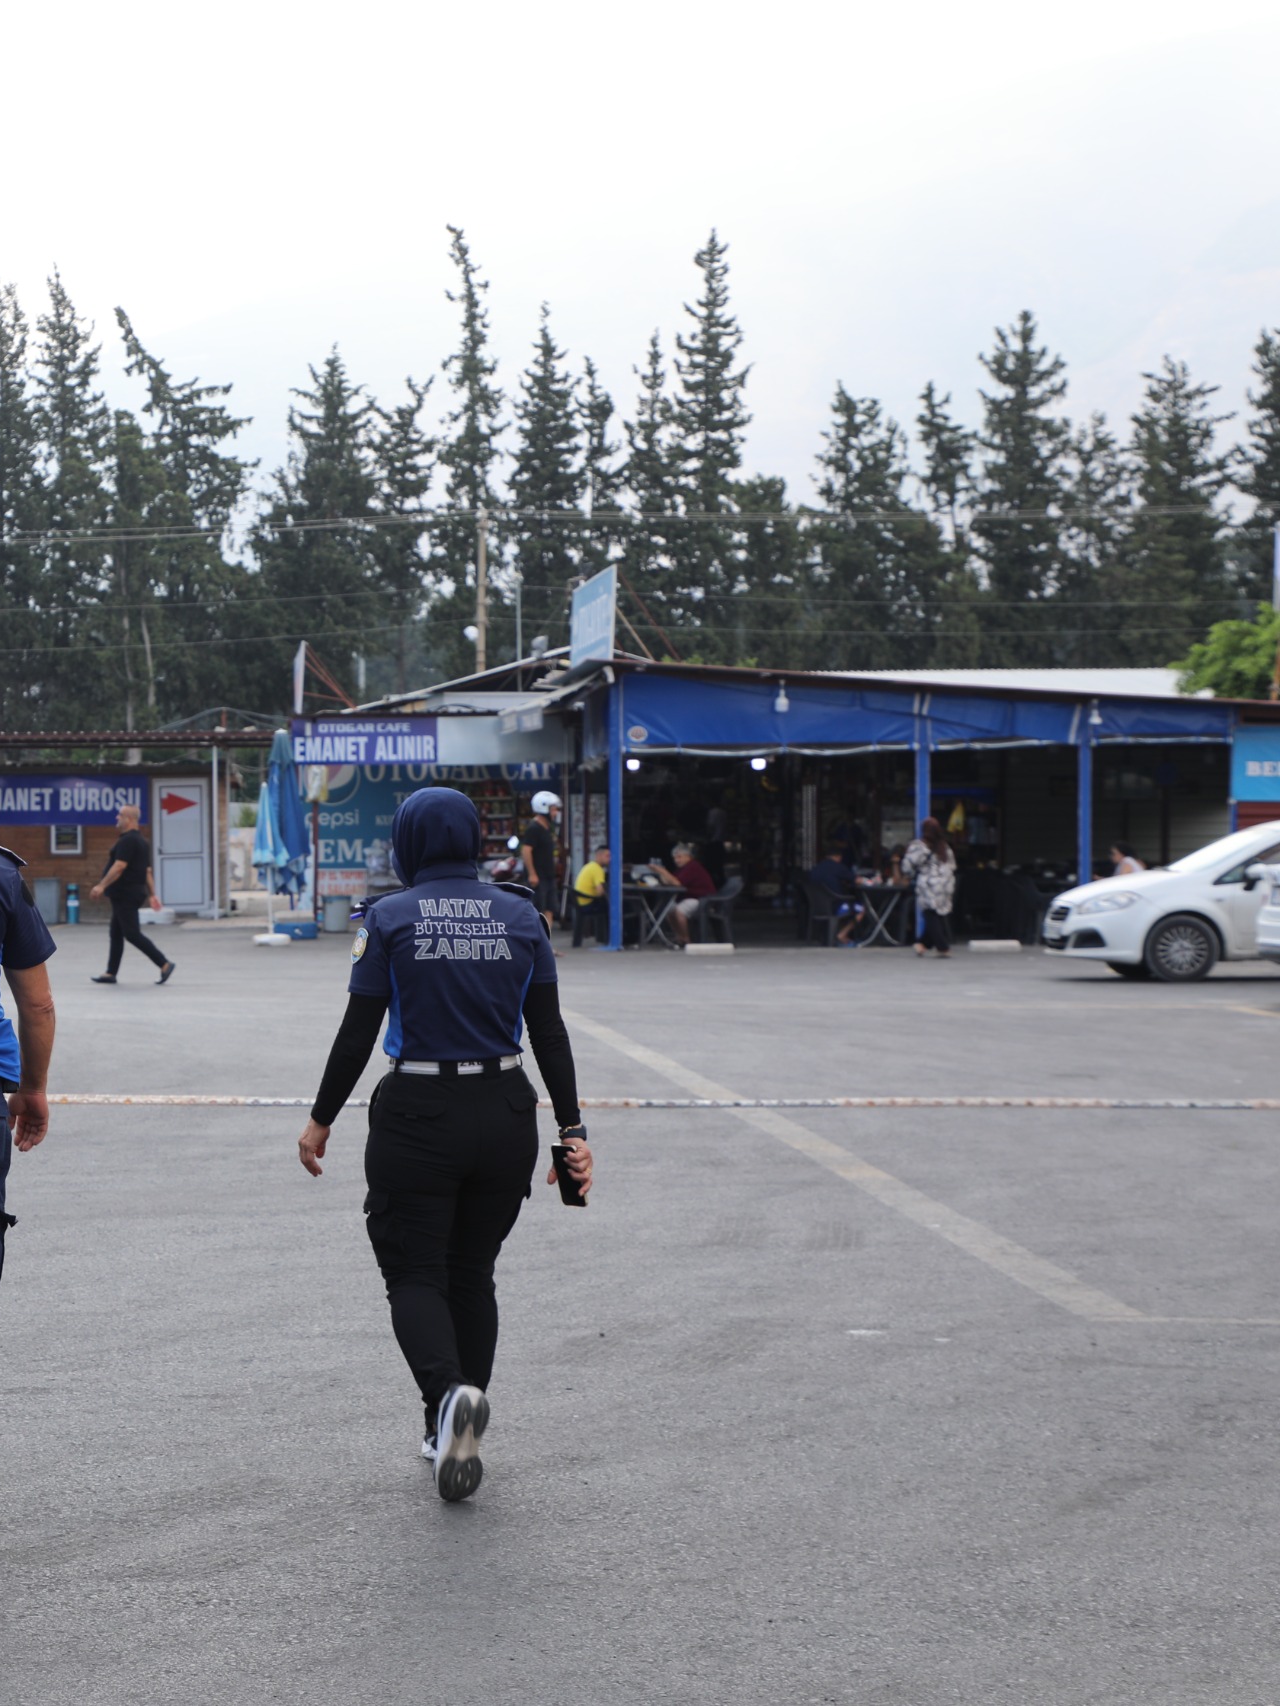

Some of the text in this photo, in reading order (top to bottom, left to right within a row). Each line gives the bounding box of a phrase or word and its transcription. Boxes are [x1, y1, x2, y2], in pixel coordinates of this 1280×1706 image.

[318, 722, 411, 733] OTOGAR CAFE
[294, 735, 435, 762] EMANET ALINIR
[60, 782, 141, 811] BÜROSU
[418, 898, 491, 918] HATAY
[414, 919, 507, 938] BÜYÜKŞEHİR
[414, 938, 512, 960] ZABITA
